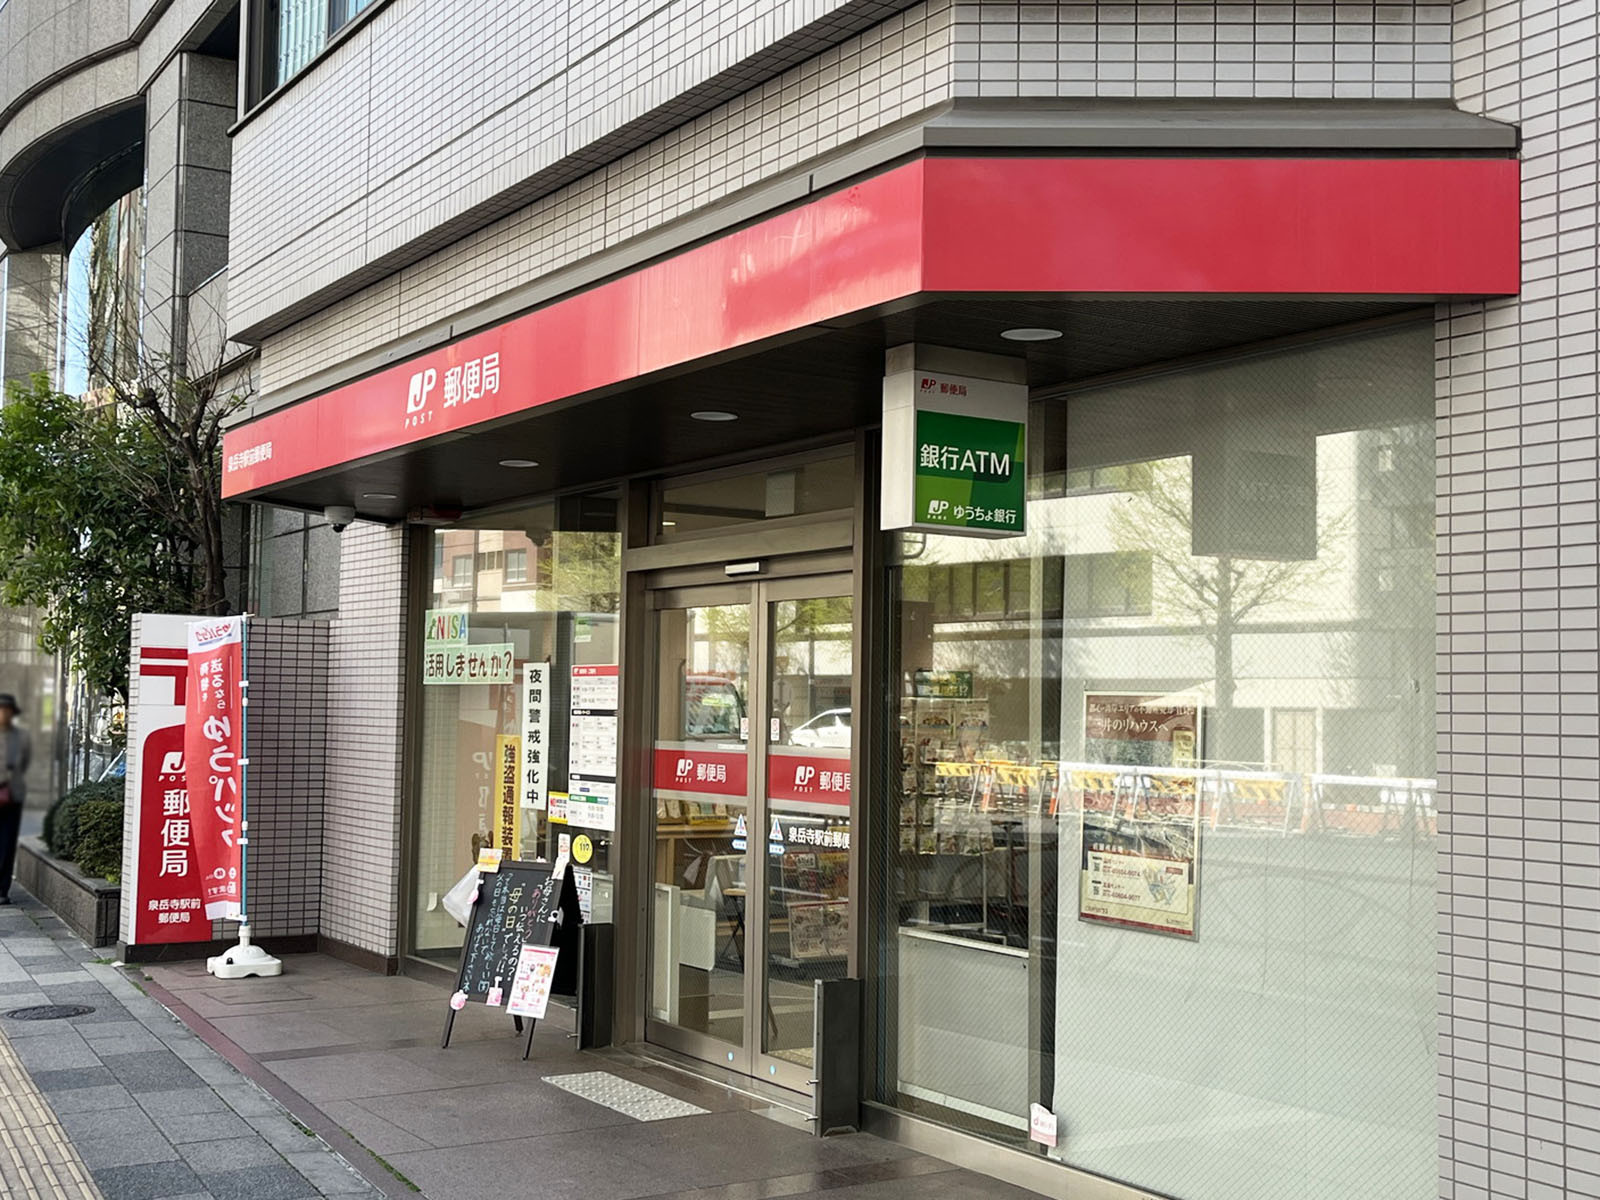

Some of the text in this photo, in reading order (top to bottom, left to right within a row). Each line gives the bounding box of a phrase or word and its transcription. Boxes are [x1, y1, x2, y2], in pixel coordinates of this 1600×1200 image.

[406, 352, 500, 413] JP 郵便局
[404, 411, 433, 429] POST
[920, 443, 1010, 476] 銀行ATM
[953, 505, 1017, 524] ゆうちょ銀行
[437, 613, 467, 640] NISA
[425, 650, 512, 678] 活用しませんか?
[696, 763, 726, 784] 郵便局
[793, 785, 813, 793] POST
[160, 788, 190, 878] 郵便局
[148, 898, 202, 911] 泉岳寺駅前
[536, 876, 554, 923] お母さんに
[158, 911, 190, 924] 郵便局
